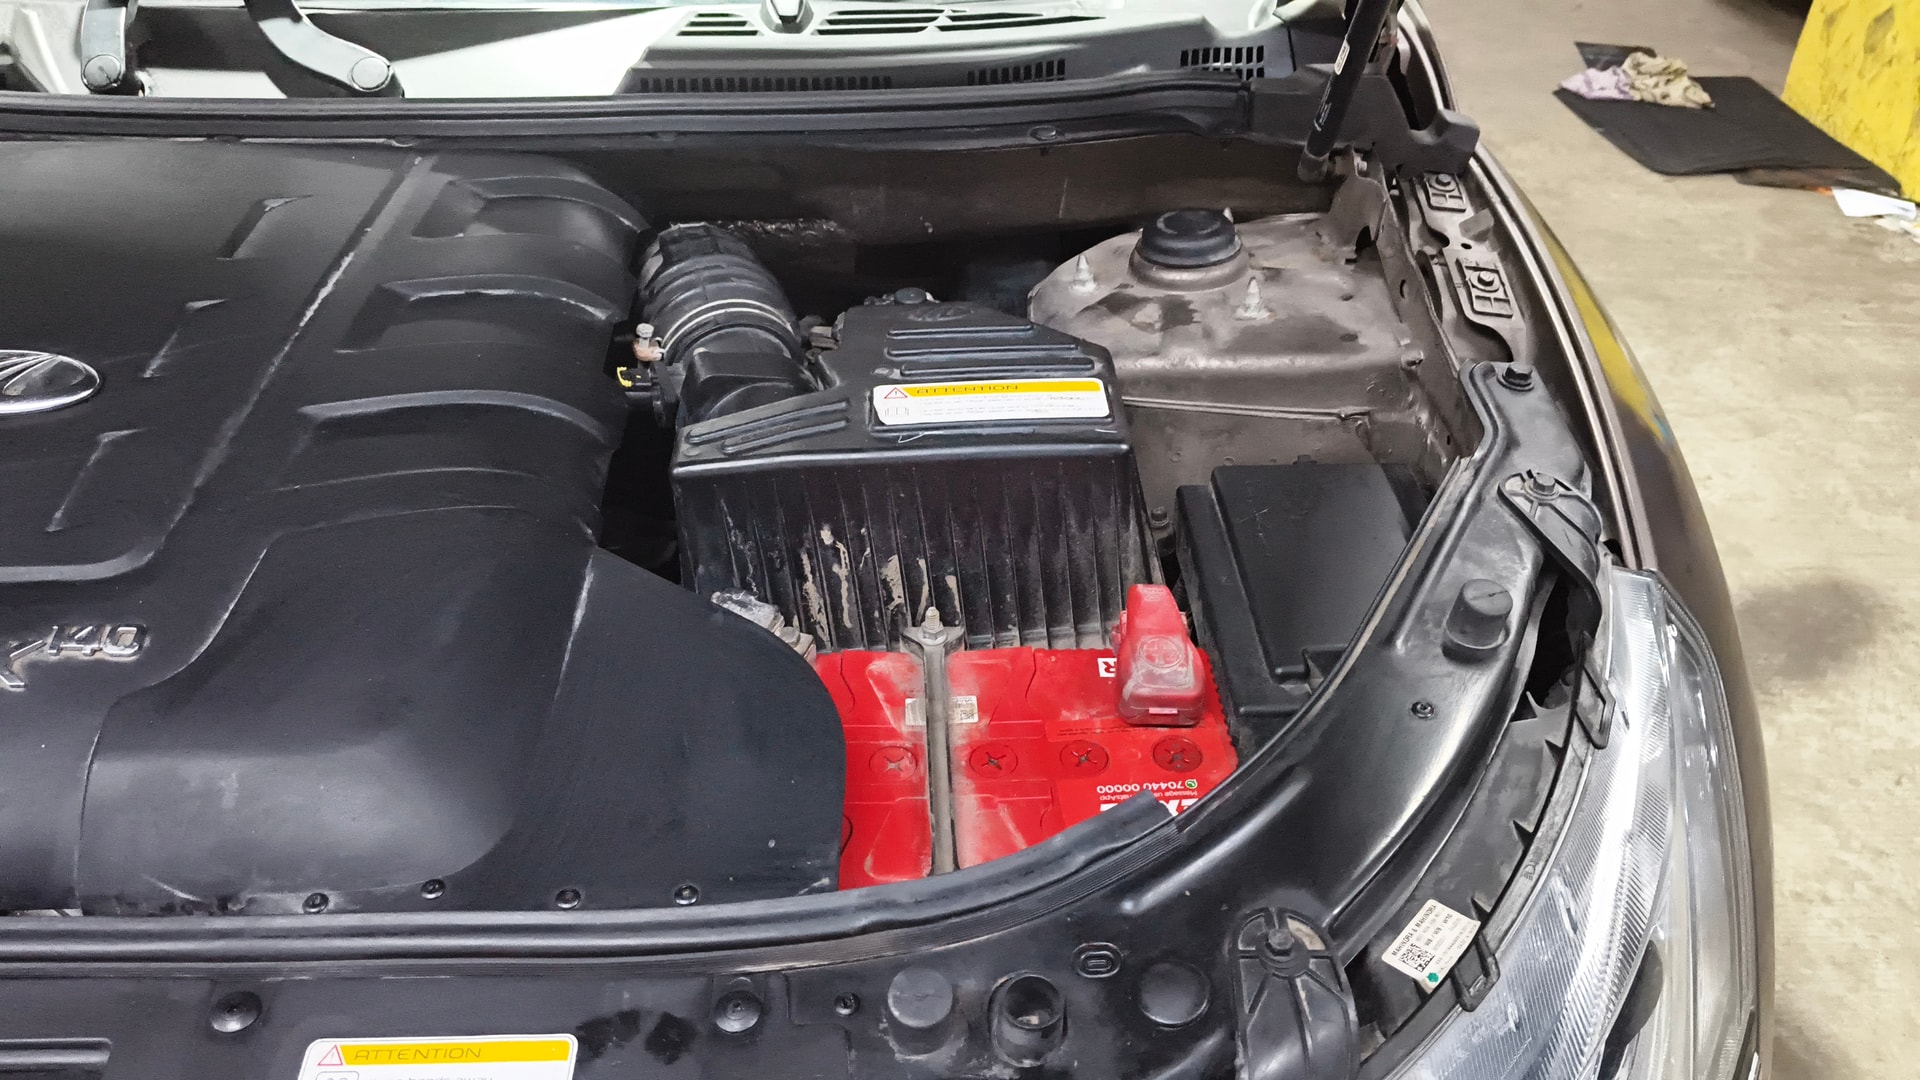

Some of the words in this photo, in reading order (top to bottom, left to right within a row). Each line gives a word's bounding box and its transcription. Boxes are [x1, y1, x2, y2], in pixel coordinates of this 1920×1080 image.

[916, 384, 1019, 395] ATTENTION
[1096, 783, 1140, 794] 00000
[1143, 780, 1185, 791] 70440
[1391, 932, 1414, 956] MAHINDRA
[1415, 904, 1437, 928] MAHINDRA
[354, 1047, 482, 1060] ATTENTION
